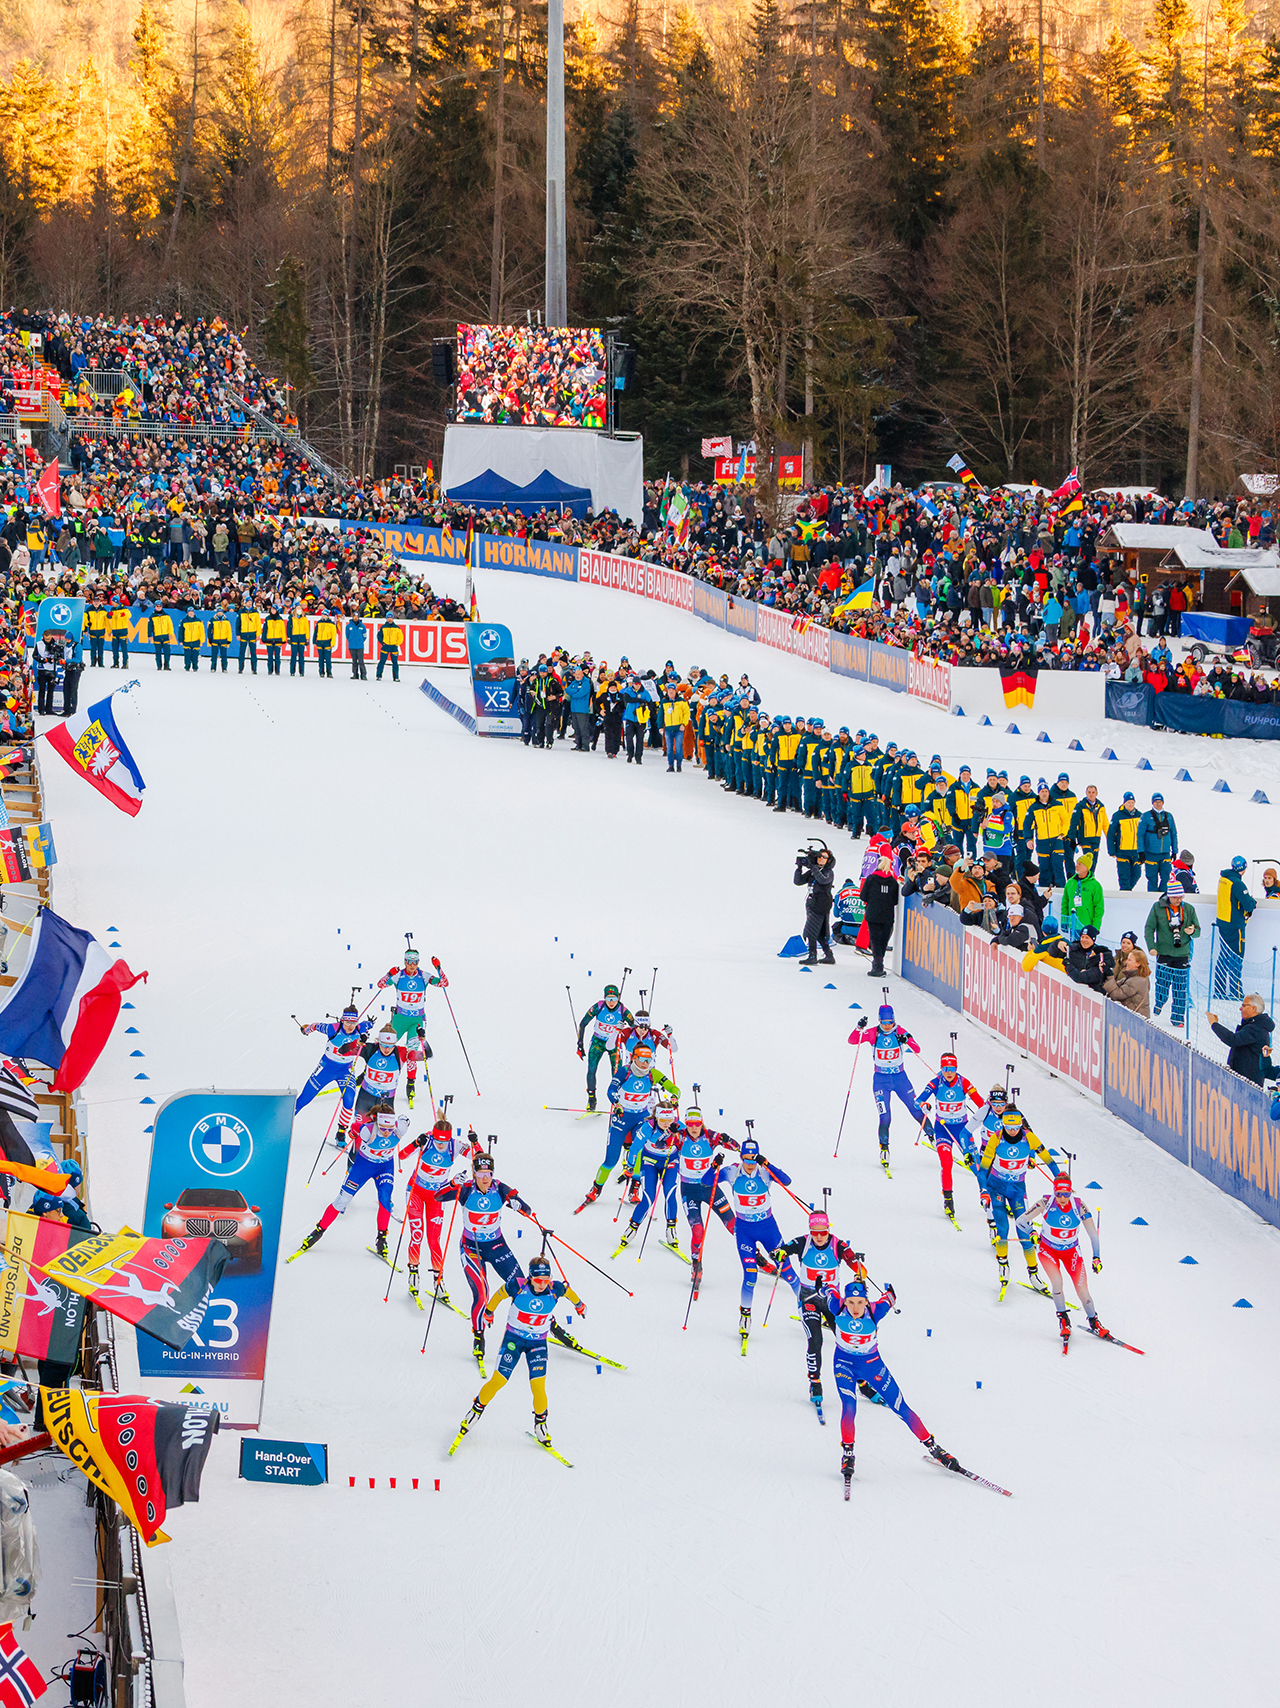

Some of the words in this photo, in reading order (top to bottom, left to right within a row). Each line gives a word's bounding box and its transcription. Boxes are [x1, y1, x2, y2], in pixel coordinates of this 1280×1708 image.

[484, 540, 575, 574] HÖRMANN
[580, 554, 646, 594] BAUHAUS
[647, 567, 694, 610] BAUHAUS
[757, 611, 794, 652] BAUHAUS
[484, 689, 511, 708] X3
[904, 907, 960, 991] HÖRMANN
[964, 943, 1026, 1034] BAUHAUS
[1029, 976, 1102, 1078] BAUHAUS
[1108, 1022, 1183, 1138] HÖRMANN
[198, 1116, 245, 1134] BMW
[478, 1158, 491, 1166] ice
[409, 1218, 424, 1248] POL
[162, 1351, 240, 1361] PLUG-IN-HYBRID
[255, 1450, 313, 1466] Hand-Over
[264, 1465, 301, 1478] START
